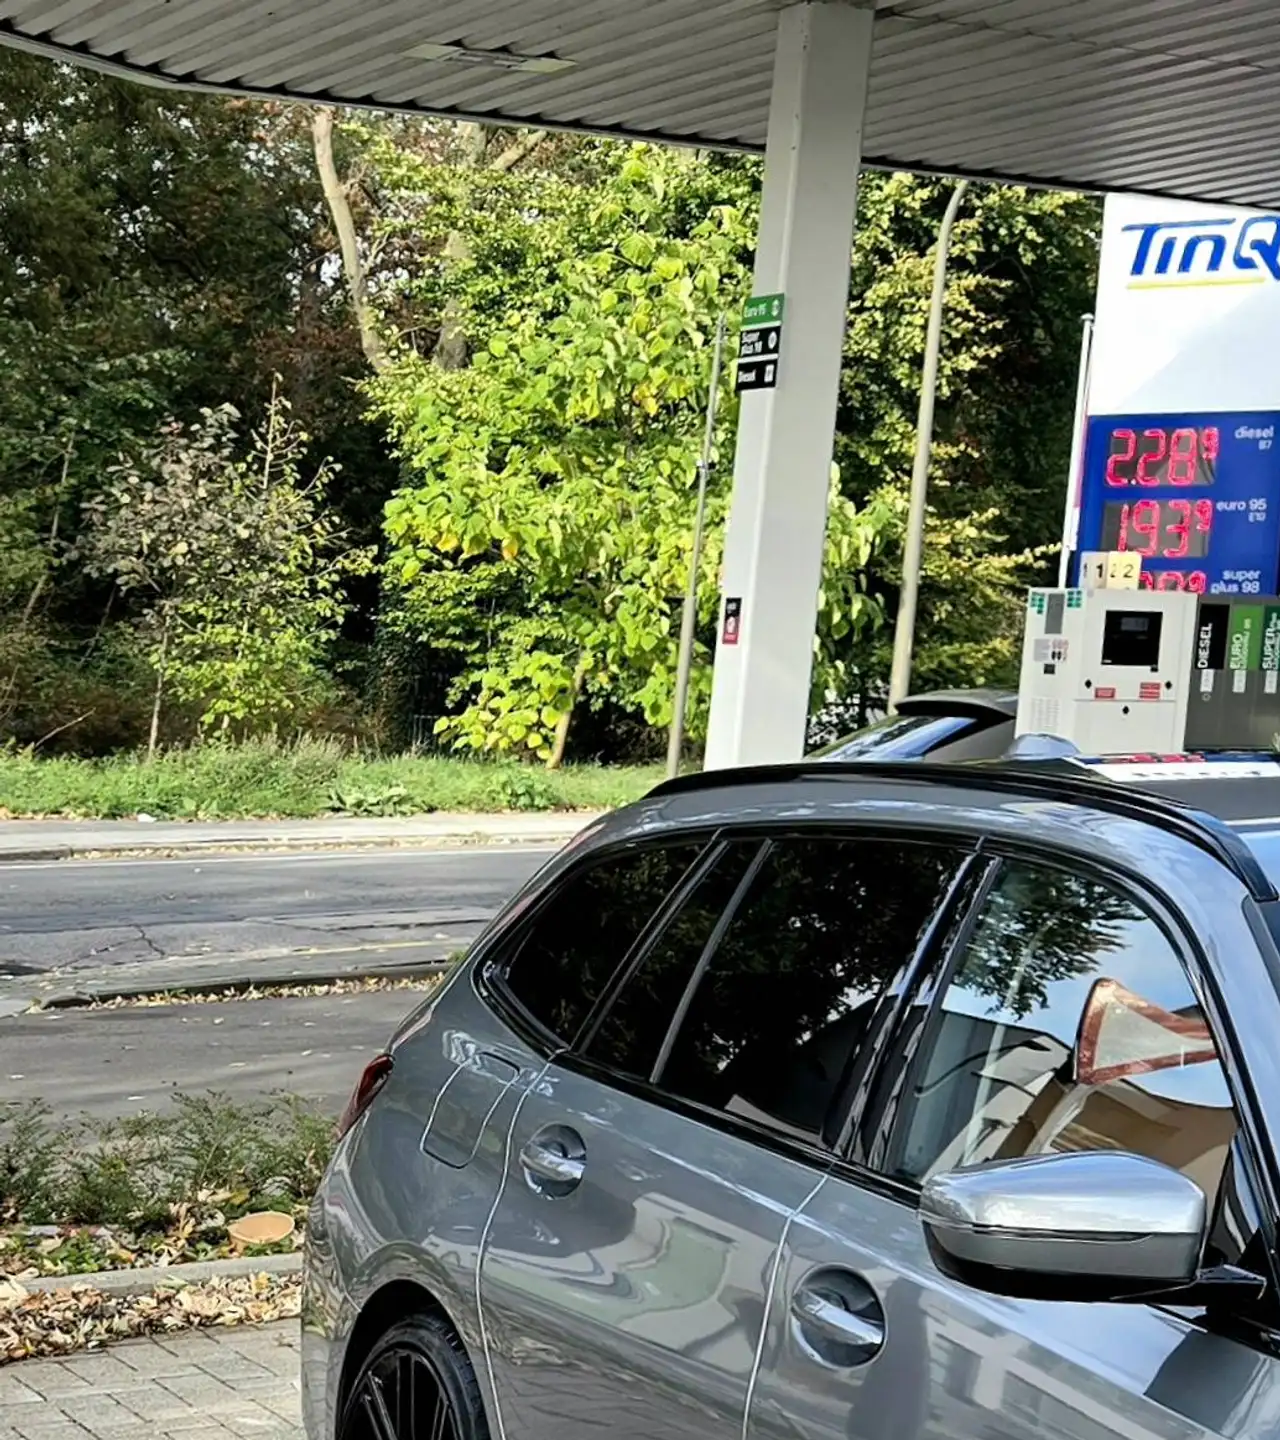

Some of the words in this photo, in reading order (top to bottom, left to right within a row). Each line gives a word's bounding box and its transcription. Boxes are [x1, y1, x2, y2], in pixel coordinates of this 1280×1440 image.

[1234, 425, 1274, 439] diesel
[1216, 501, 1246, 511] euro
[1249, 498, 1267, 511] 95
[1096, 563, 1104, 578] 1
[1123, 564, 1134, 578] 2
[1222, 570, 1261, 583] super
[1210, 580, 1239, 594] plus
[1241, 581, 1260, 593] 98
[1197, 623, 1213, 668] DIESEL
[1230, 633, 1243, 669] EURO
[1262, 628, 1275, 669] SUPER
